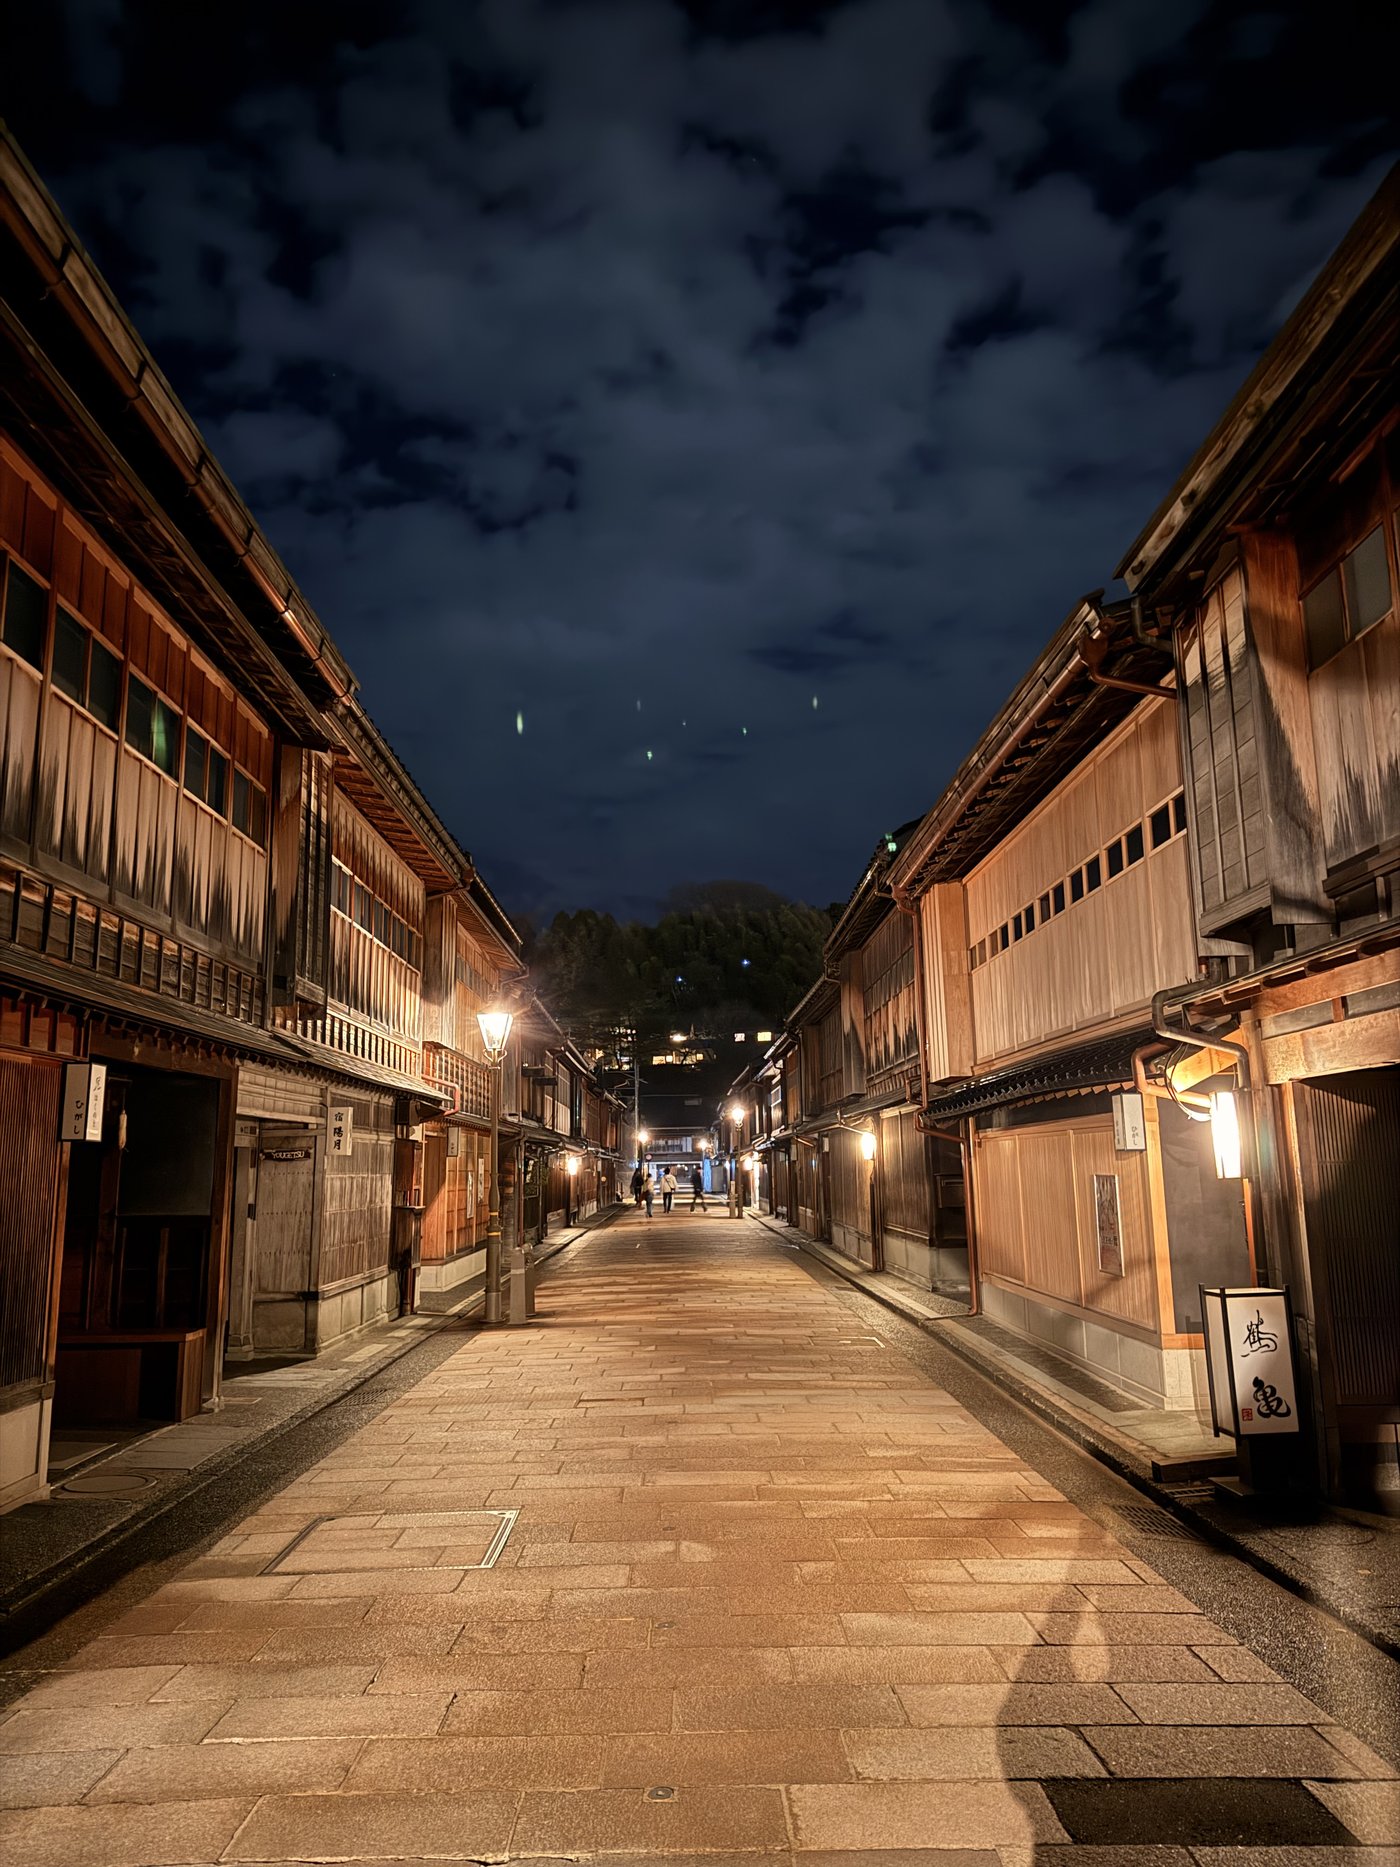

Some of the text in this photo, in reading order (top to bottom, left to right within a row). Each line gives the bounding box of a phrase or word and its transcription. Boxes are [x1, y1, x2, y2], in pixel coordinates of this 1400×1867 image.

[74, 1100, 84, 1134] ひがし
[272, 1151, 304, 1159] YOUGETSU
